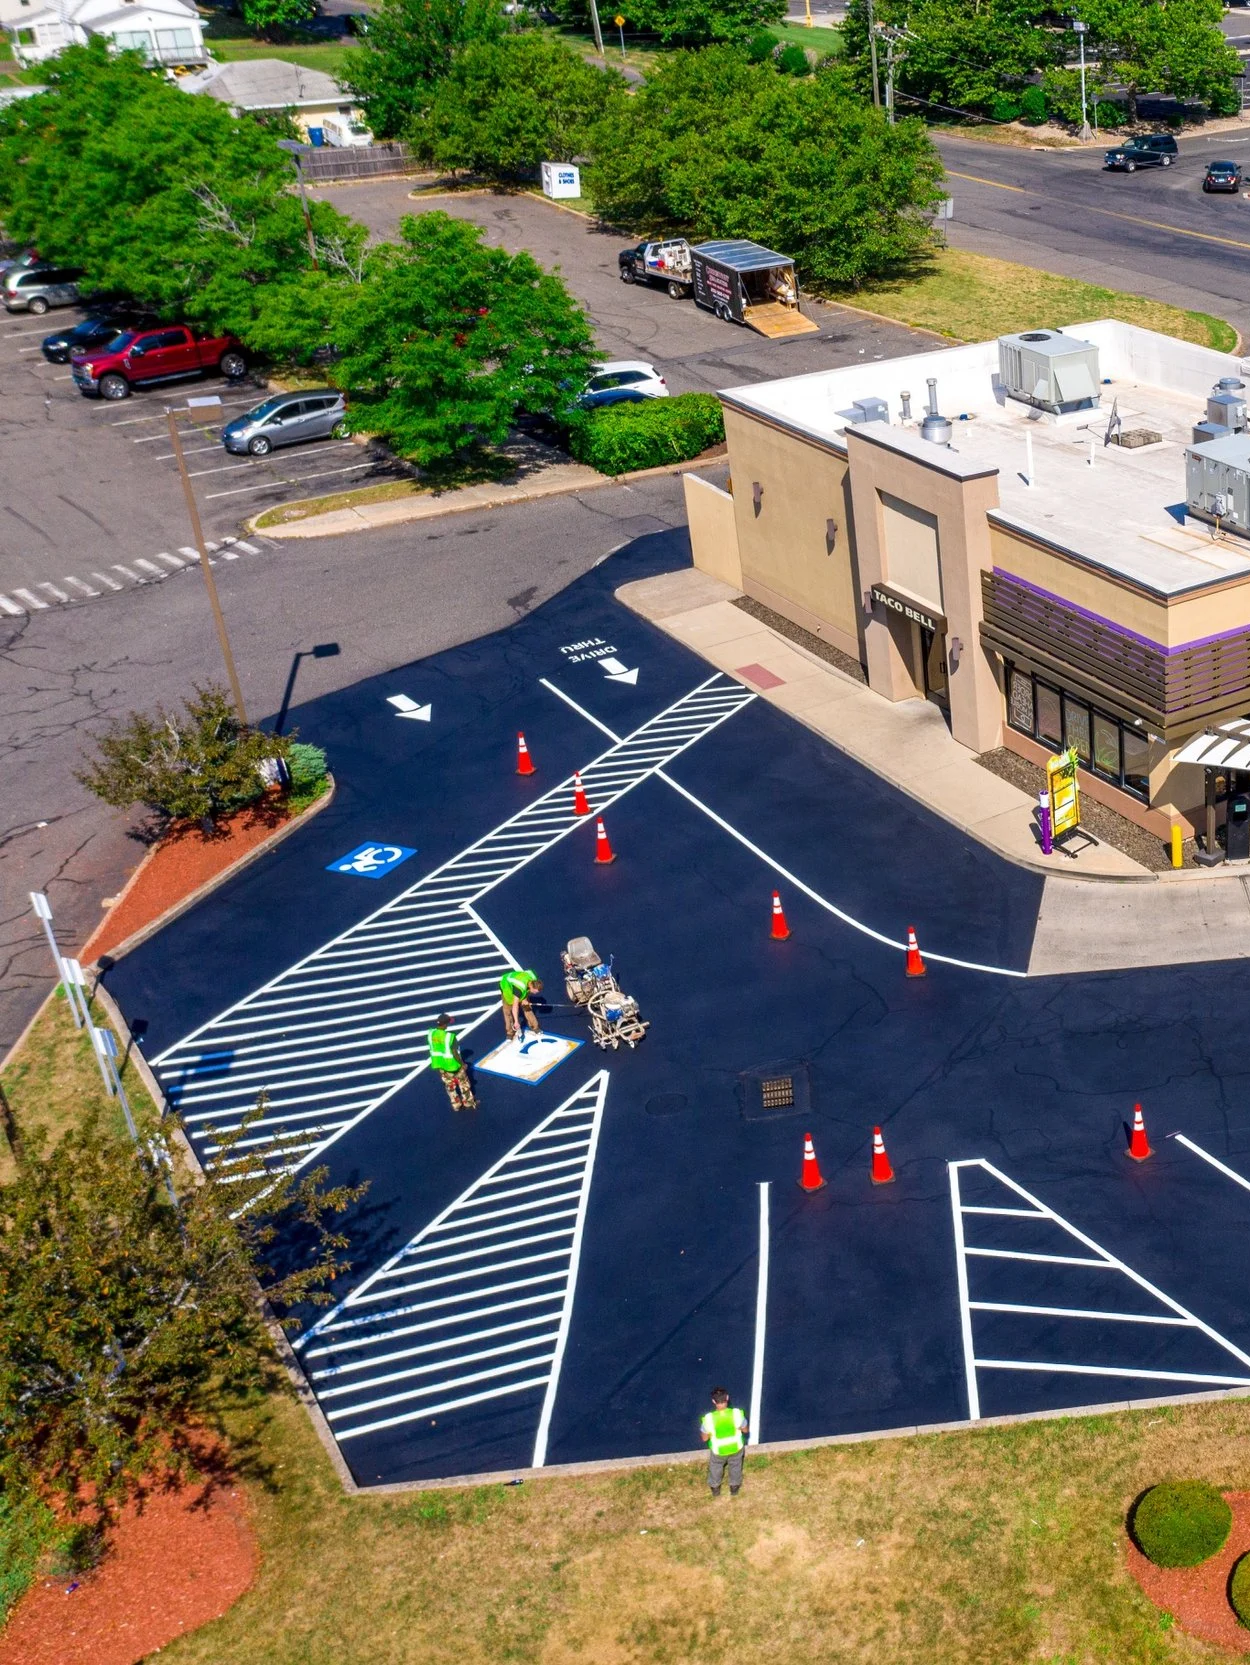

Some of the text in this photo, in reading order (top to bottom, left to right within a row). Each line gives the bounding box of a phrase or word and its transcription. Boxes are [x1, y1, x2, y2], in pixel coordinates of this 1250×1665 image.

[873, 589, 936, 631] TACO BELL
[558, 637, 606, 654] THRU
[568, 645, 618, 663] DRIVE
